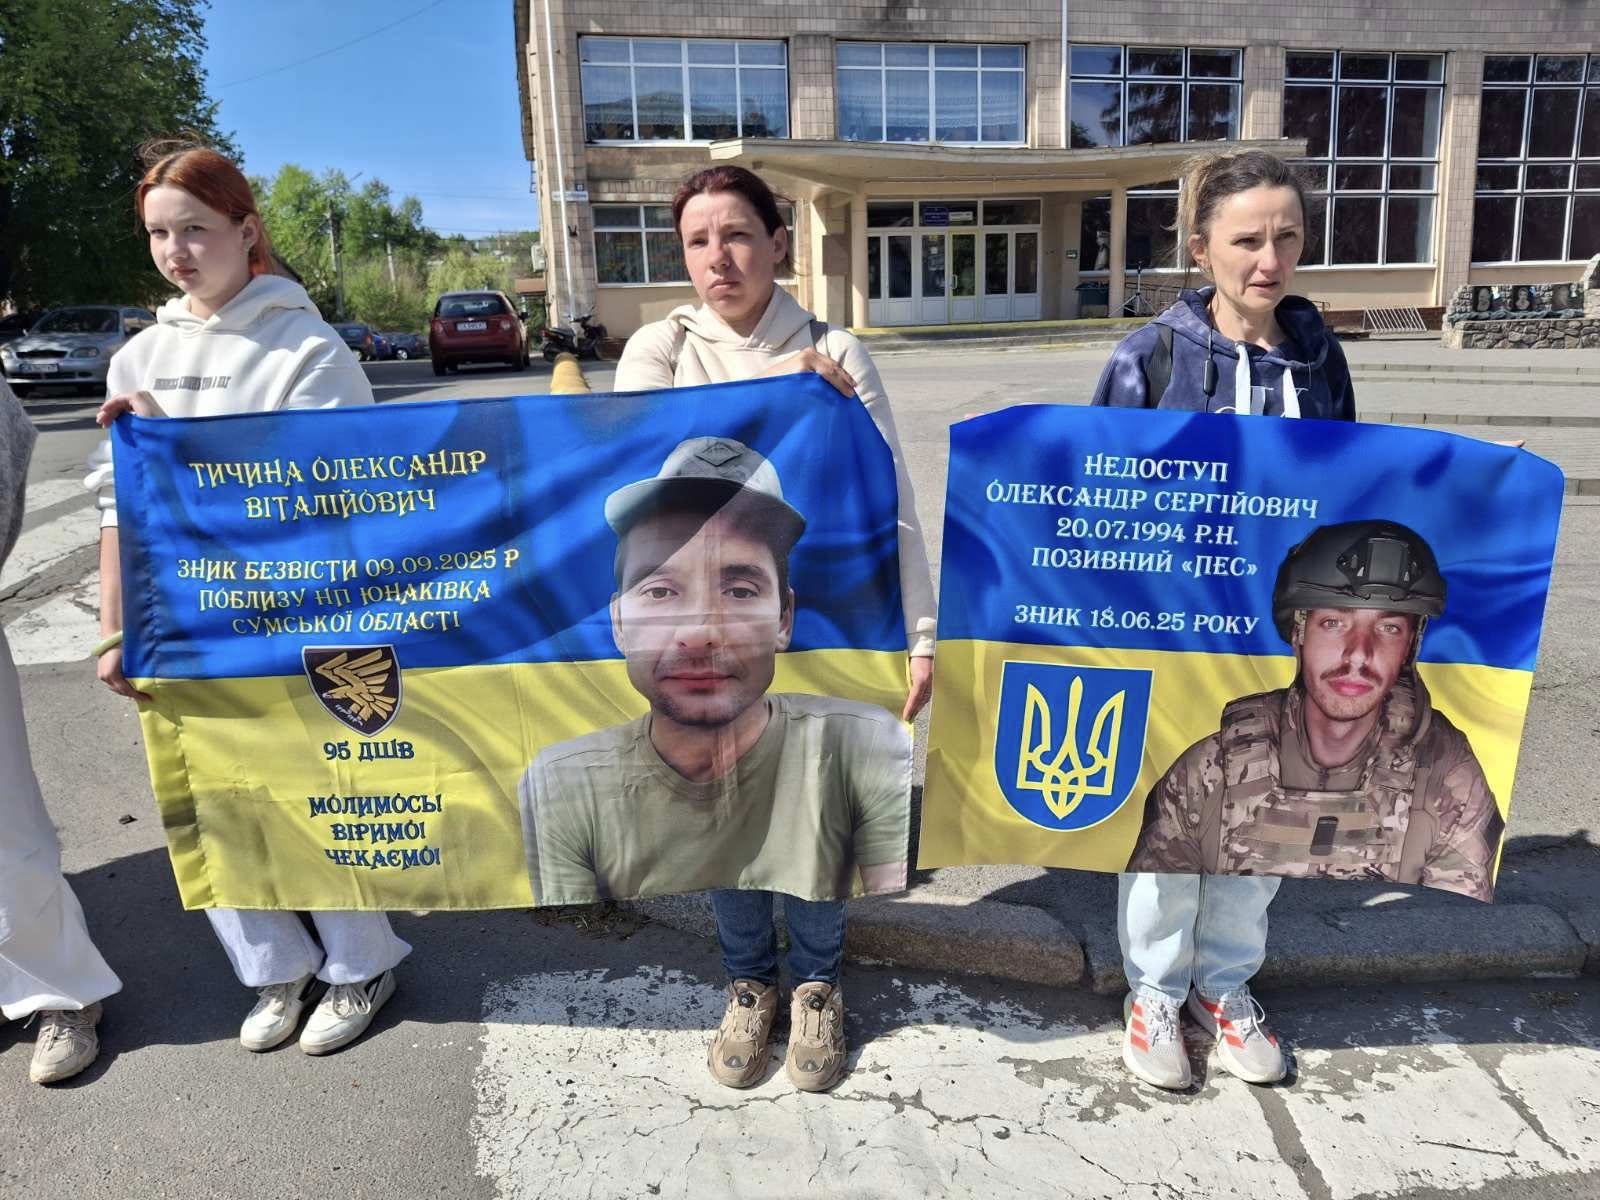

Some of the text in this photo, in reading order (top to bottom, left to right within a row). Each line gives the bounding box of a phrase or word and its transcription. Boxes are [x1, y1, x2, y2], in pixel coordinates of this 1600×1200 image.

[188, 449, 487, 489] ТИЧИНА ОЛЕКСАНДР
[1083, 452, 1228, 482] НЕДОСТУП
[244, 488, 438, 521] ВІТАЛІЙОВИЧ
[986, 479, 1320, 519] ОЛЕКСАНДР СЕРГІЙОВИЧ
[1056, 517, 1240, 545] 20.07.1994 Р.Н.
[177, 548, 520, 583] ЗНИК БЕЗВІСТИ 09.09.2025 Р
[1031, 547, 1258, 579] ПОЗИВНИЙ «ПЕС»
[199, 580, 491, 612] ПОБЛИЗУ НП ЮНАКІВКА
[232, 610, 461, 637] СУМСЬКОЇ ОБЛАСТІ
[1014, 604, 1260, 634] ЗНИК 18.06.25 РОКУ
[323, 738, 415, 762] 95 ДШВ
[308, 793, 443, 818] МОЛИМОСЬ!
[330, 819, 426, 844] ВІРИМО!
[325, 845, 441, 869] ЧЕКАЄМО!
